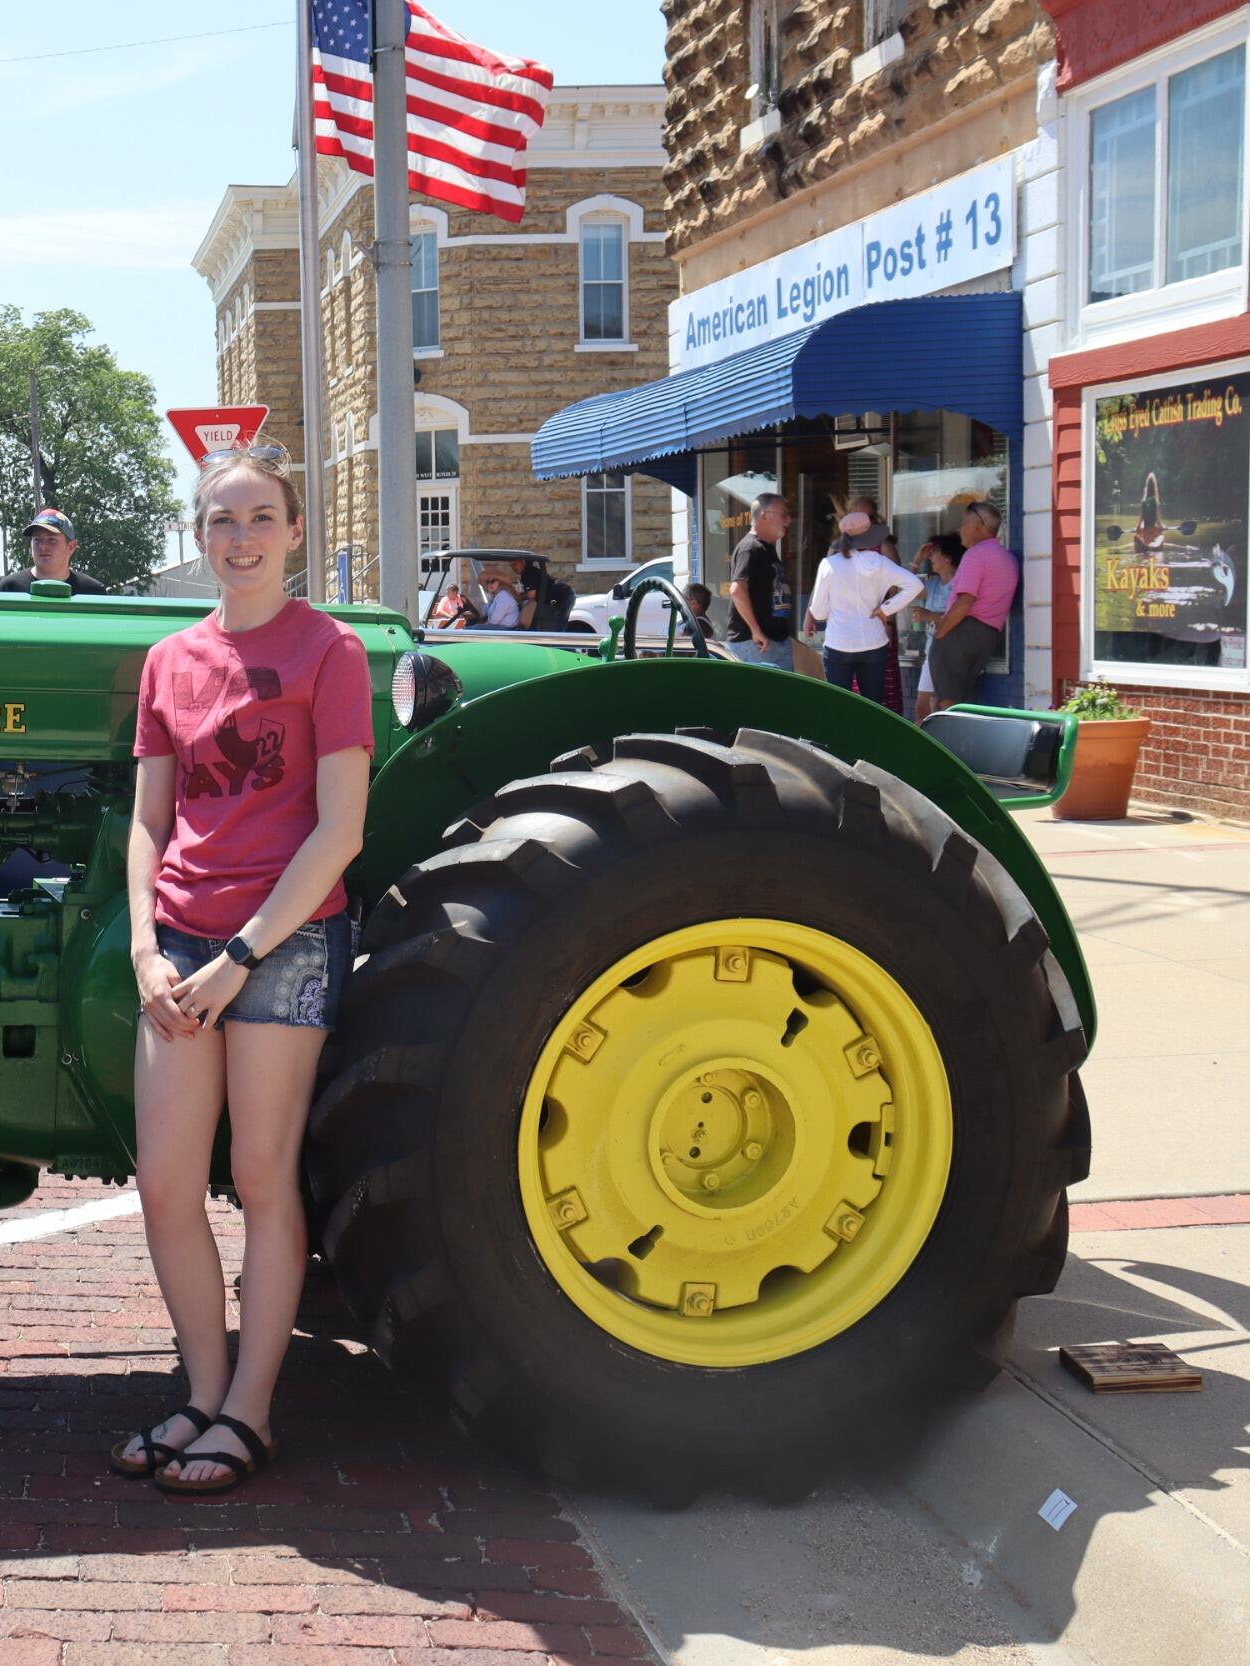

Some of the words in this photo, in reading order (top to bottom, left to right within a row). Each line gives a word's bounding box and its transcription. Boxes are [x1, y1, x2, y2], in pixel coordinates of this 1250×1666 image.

[685, 294, 768, 351] American
[776, 262, 849, 323] Legion
[865, 224, 926, 289] Post
[936, 209, 953, 264] #
[965, 192, 1003, 250] 13
[1129, 400, 1150, 437] Eyed
[1152, 397, 1183, 426] Catfish
[1186, 389, 1222, 426] Trading
[1225, 385, 1242, 415] Co.
[203, 430, 233, 442] YIELD
[1107, 557, 1169, 600] Kayaks
[1136, 603, 1145, 617] &
[1149, 604, 1176, 617] more
[256, 731, 279, 755] 22
[181, 754, 285, 800] AYS
